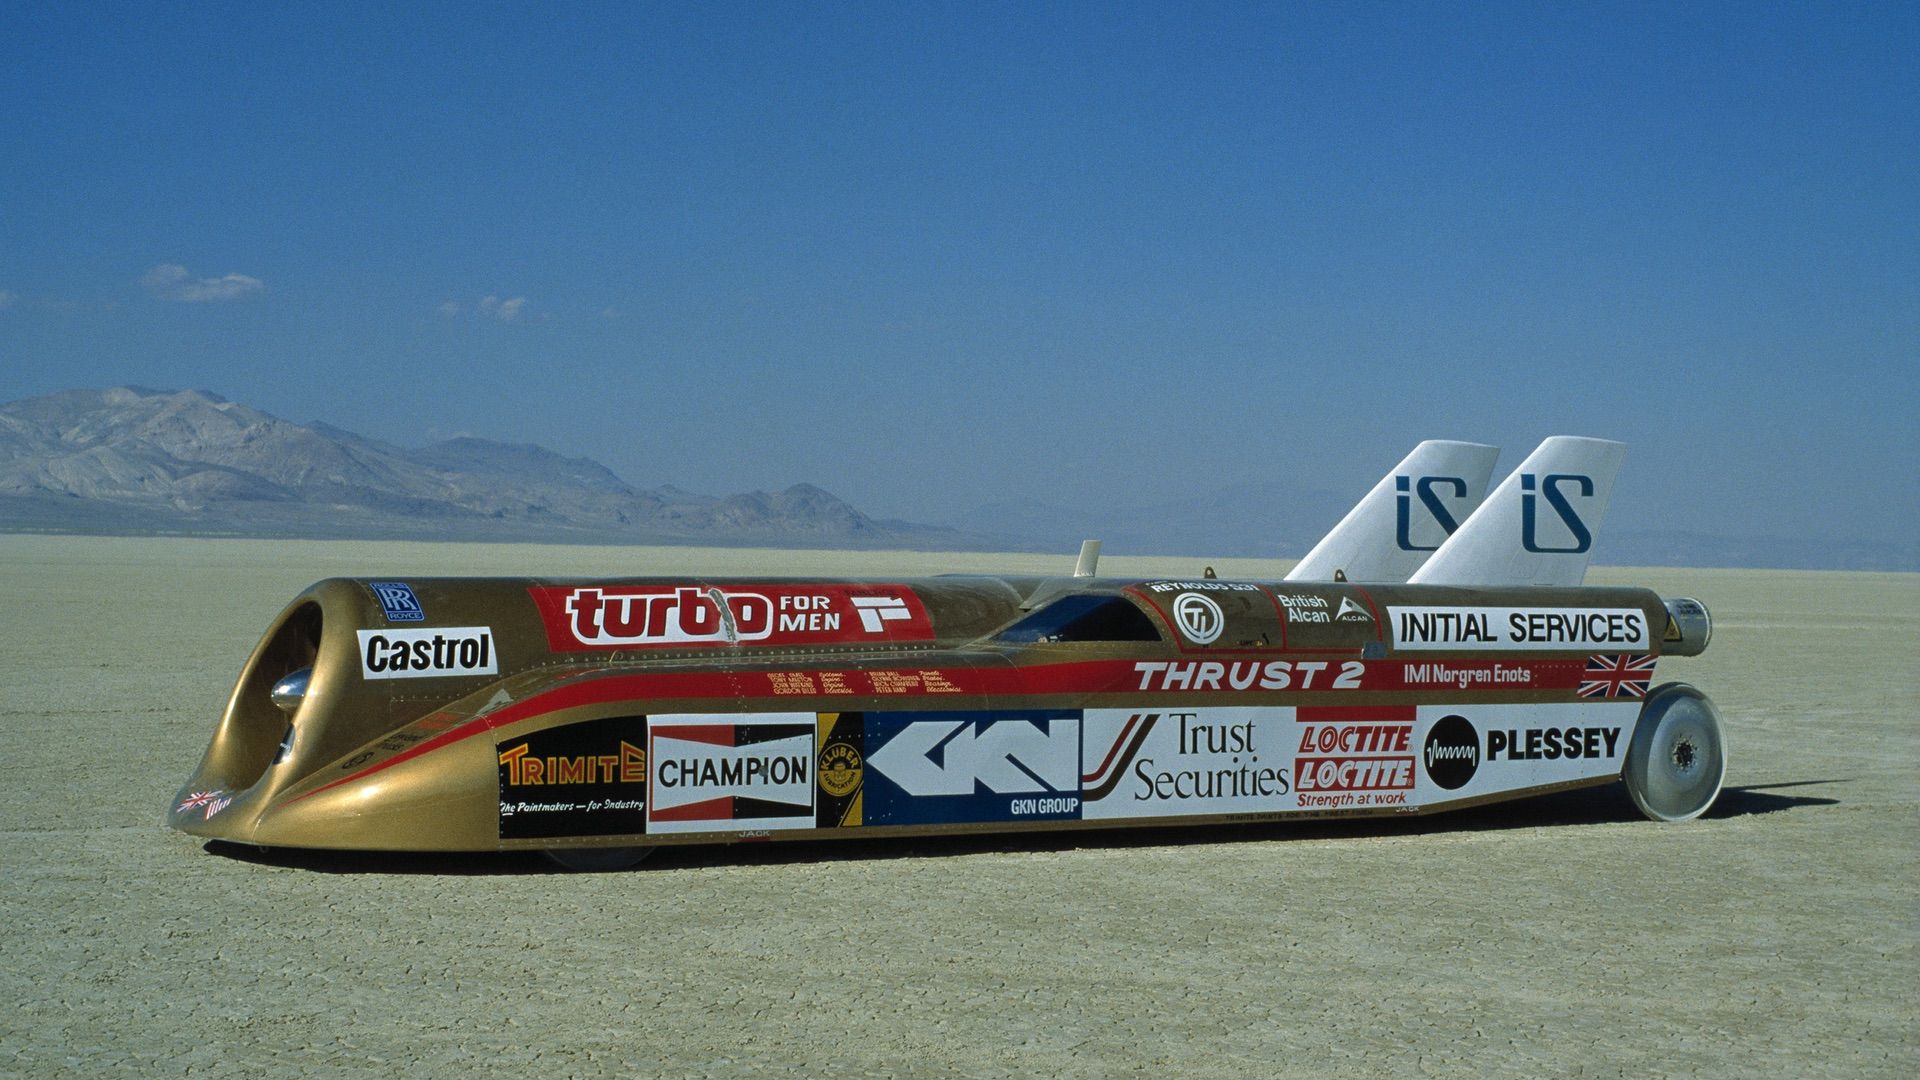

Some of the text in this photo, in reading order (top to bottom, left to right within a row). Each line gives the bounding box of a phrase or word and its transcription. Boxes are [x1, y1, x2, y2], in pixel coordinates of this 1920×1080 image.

[1150, 582, 1228, 592] REYNOLDS
[1277, 594, 1328, 607] British
[567, 588, 772, 643] turbo
[780, 595, 831, 610] FOR
[1289, 607, 1330, 622] Alcan
[779, 613, 840, 631] MEN
[1400, 612, 1641, 643] INITIAL SERVICES
[366, 633, 489, 672] Castrol
[1134, 660, 1365, 690] THRUST 2
[1404, 664, 1531, 689] IMI Norgren Enots
[1169, 712, 1256, 755] Trust
[1298, 726, 1413, 753] LOCTITE
[1487, 727, 1621, 761] PLESSEY
[499, 740, 646, 786] TRIMITE
[658, 756, 808, 787] CHAMPION
[1297, 760, 1413, 789] LOCTITE
[1134, 755, 1289, 801] Securities
[500, 802, 515, 814] The
[517, 801, 575, 812] Paintmakers
[586, 800, 602, 812] for
[604, 799, 644, 811] Industry
[1011, 798, 1079, 815] GKN GROUP
[1297, 792, 1406, 807] Strength at work
[738, 830, 770, 838] JACK
